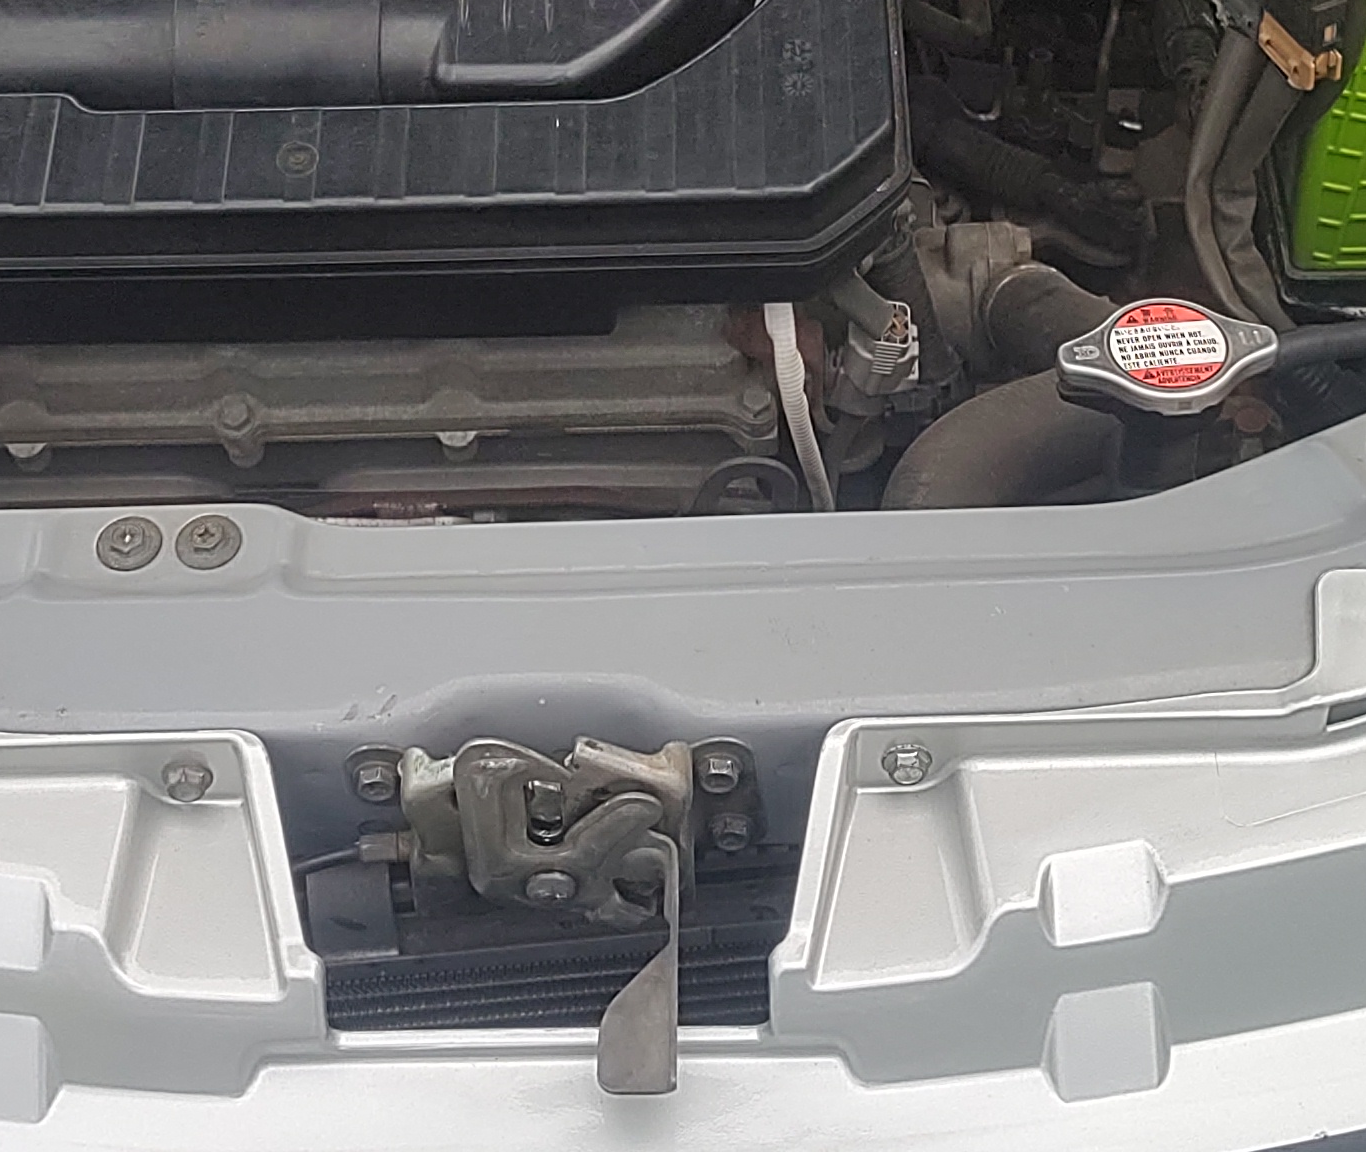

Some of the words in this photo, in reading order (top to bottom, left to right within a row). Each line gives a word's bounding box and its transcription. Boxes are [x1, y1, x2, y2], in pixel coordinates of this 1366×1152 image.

[1143, 316, 1177, 324] WARNING
[1116, 336, 1140, 346] NEVER
[1142, 334, 1162, 343] OPEN
[1164, 332, 1186, 341] WHEN
[1118, 346, 1128, 354] NE
[1130, 343, 1156, 352] JAMAIS
[1158, 340, 1184, 349] OUVRIR
[1121, 353, 1132, 362] NO
[1135, 351, 1157, 360] ABRIR
[1159, 348, 1185, 357] NUNCA
[1186, 346, 1217, 355] CUANDO
[1123, 361, 1141, 370] ESTE
